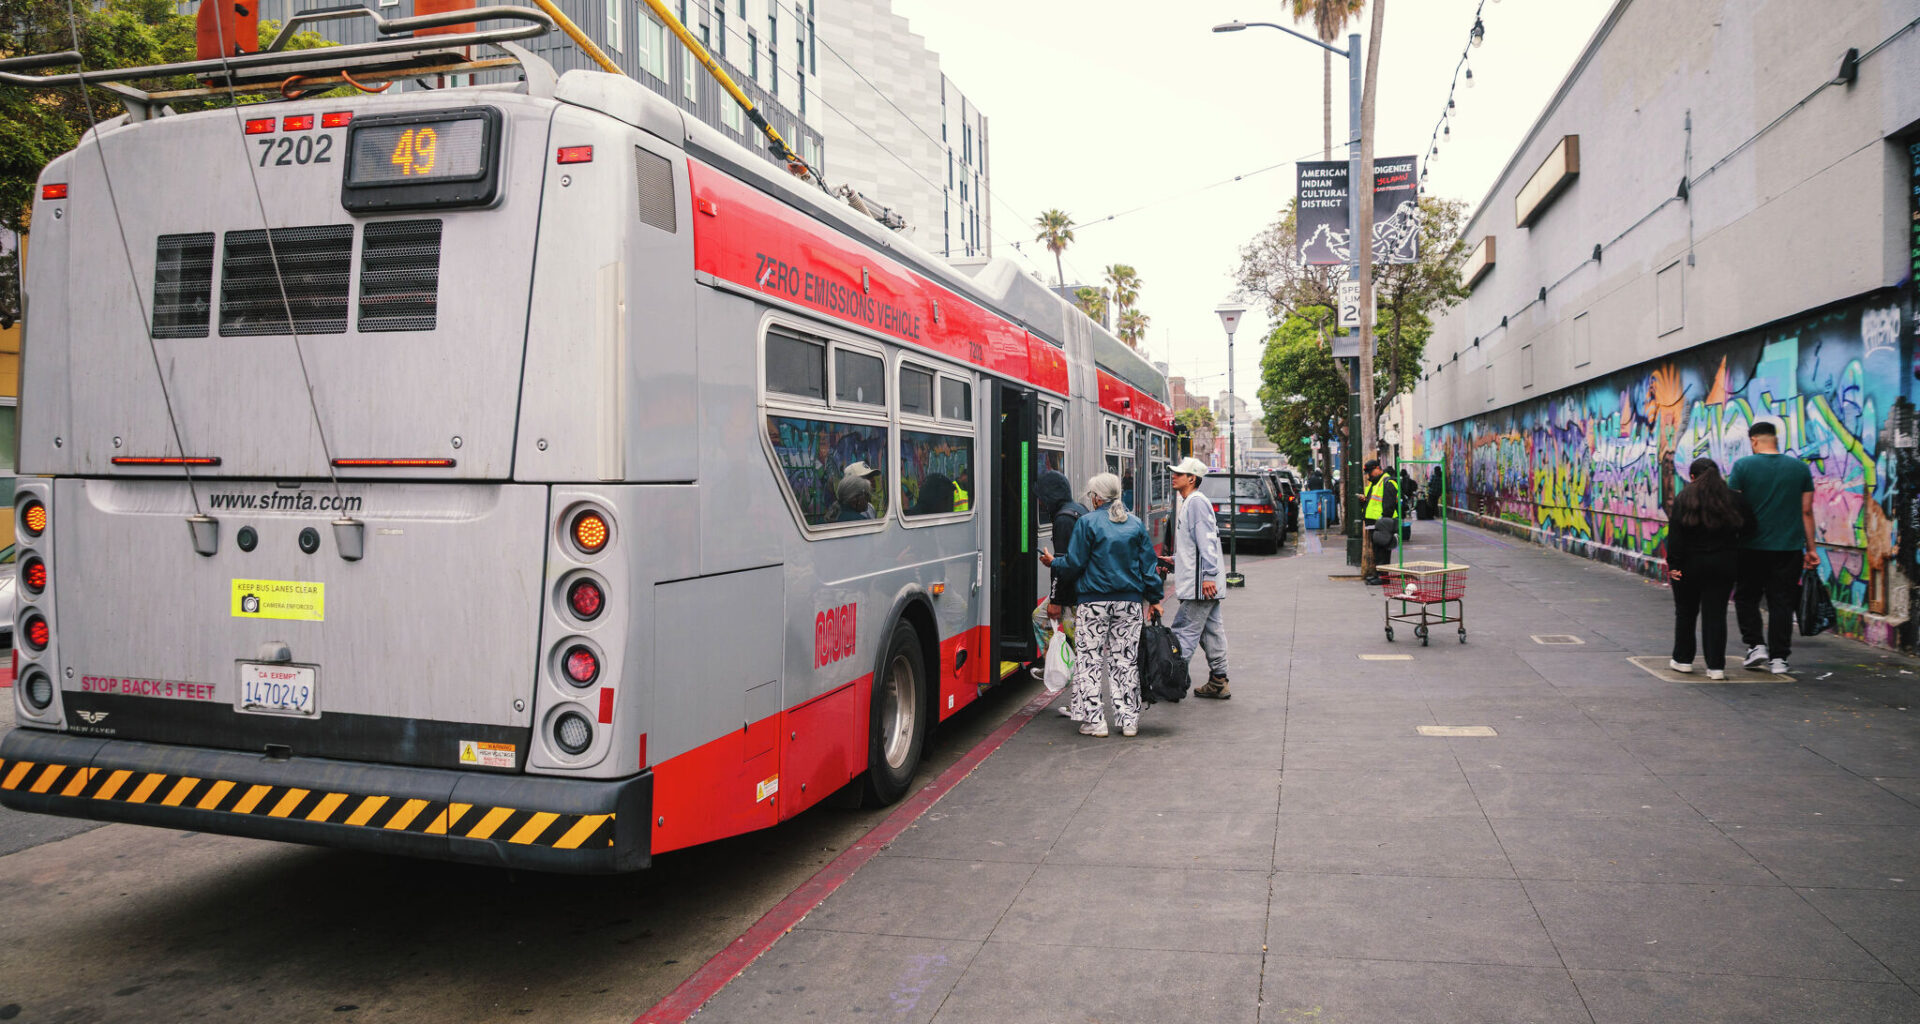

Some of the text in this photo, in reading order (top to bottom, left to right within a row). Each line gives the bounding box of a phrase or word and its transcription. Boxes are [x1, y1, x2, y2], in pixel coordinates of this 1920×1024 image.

[258, 134, 333, 167] 7202
[391, 127, 438, 175] 49
[1301, 168, 1347, 178] AMERICAN
[1374, 163, 1412, 174] DIGENIZE
[1301, 179, 1332, 188] INDIAN
[1301, 188, 1348, 198] CULTURAL
[1301, 199, 1342, 208] DISTRICT
[1342, 286, 1360, 294] SPE
[755, 252, 920, 340] ZERO EMISSIONS VEHICLE
[1344, 305, 1360, 321] 2
[968, 341, 983, 362] 7202
[210, 491, 362, 511] www.sfmta.com
[238, 583, 318, 594] KEEP BUS LANES CLEAR
[271, 672, 297, 680] EXEMPT
[82, 676, 216, 700] STOP BACK 5 FEET
[245, 681, 309, 707] 1470249
[90, 727, 116, 735] FLYER
